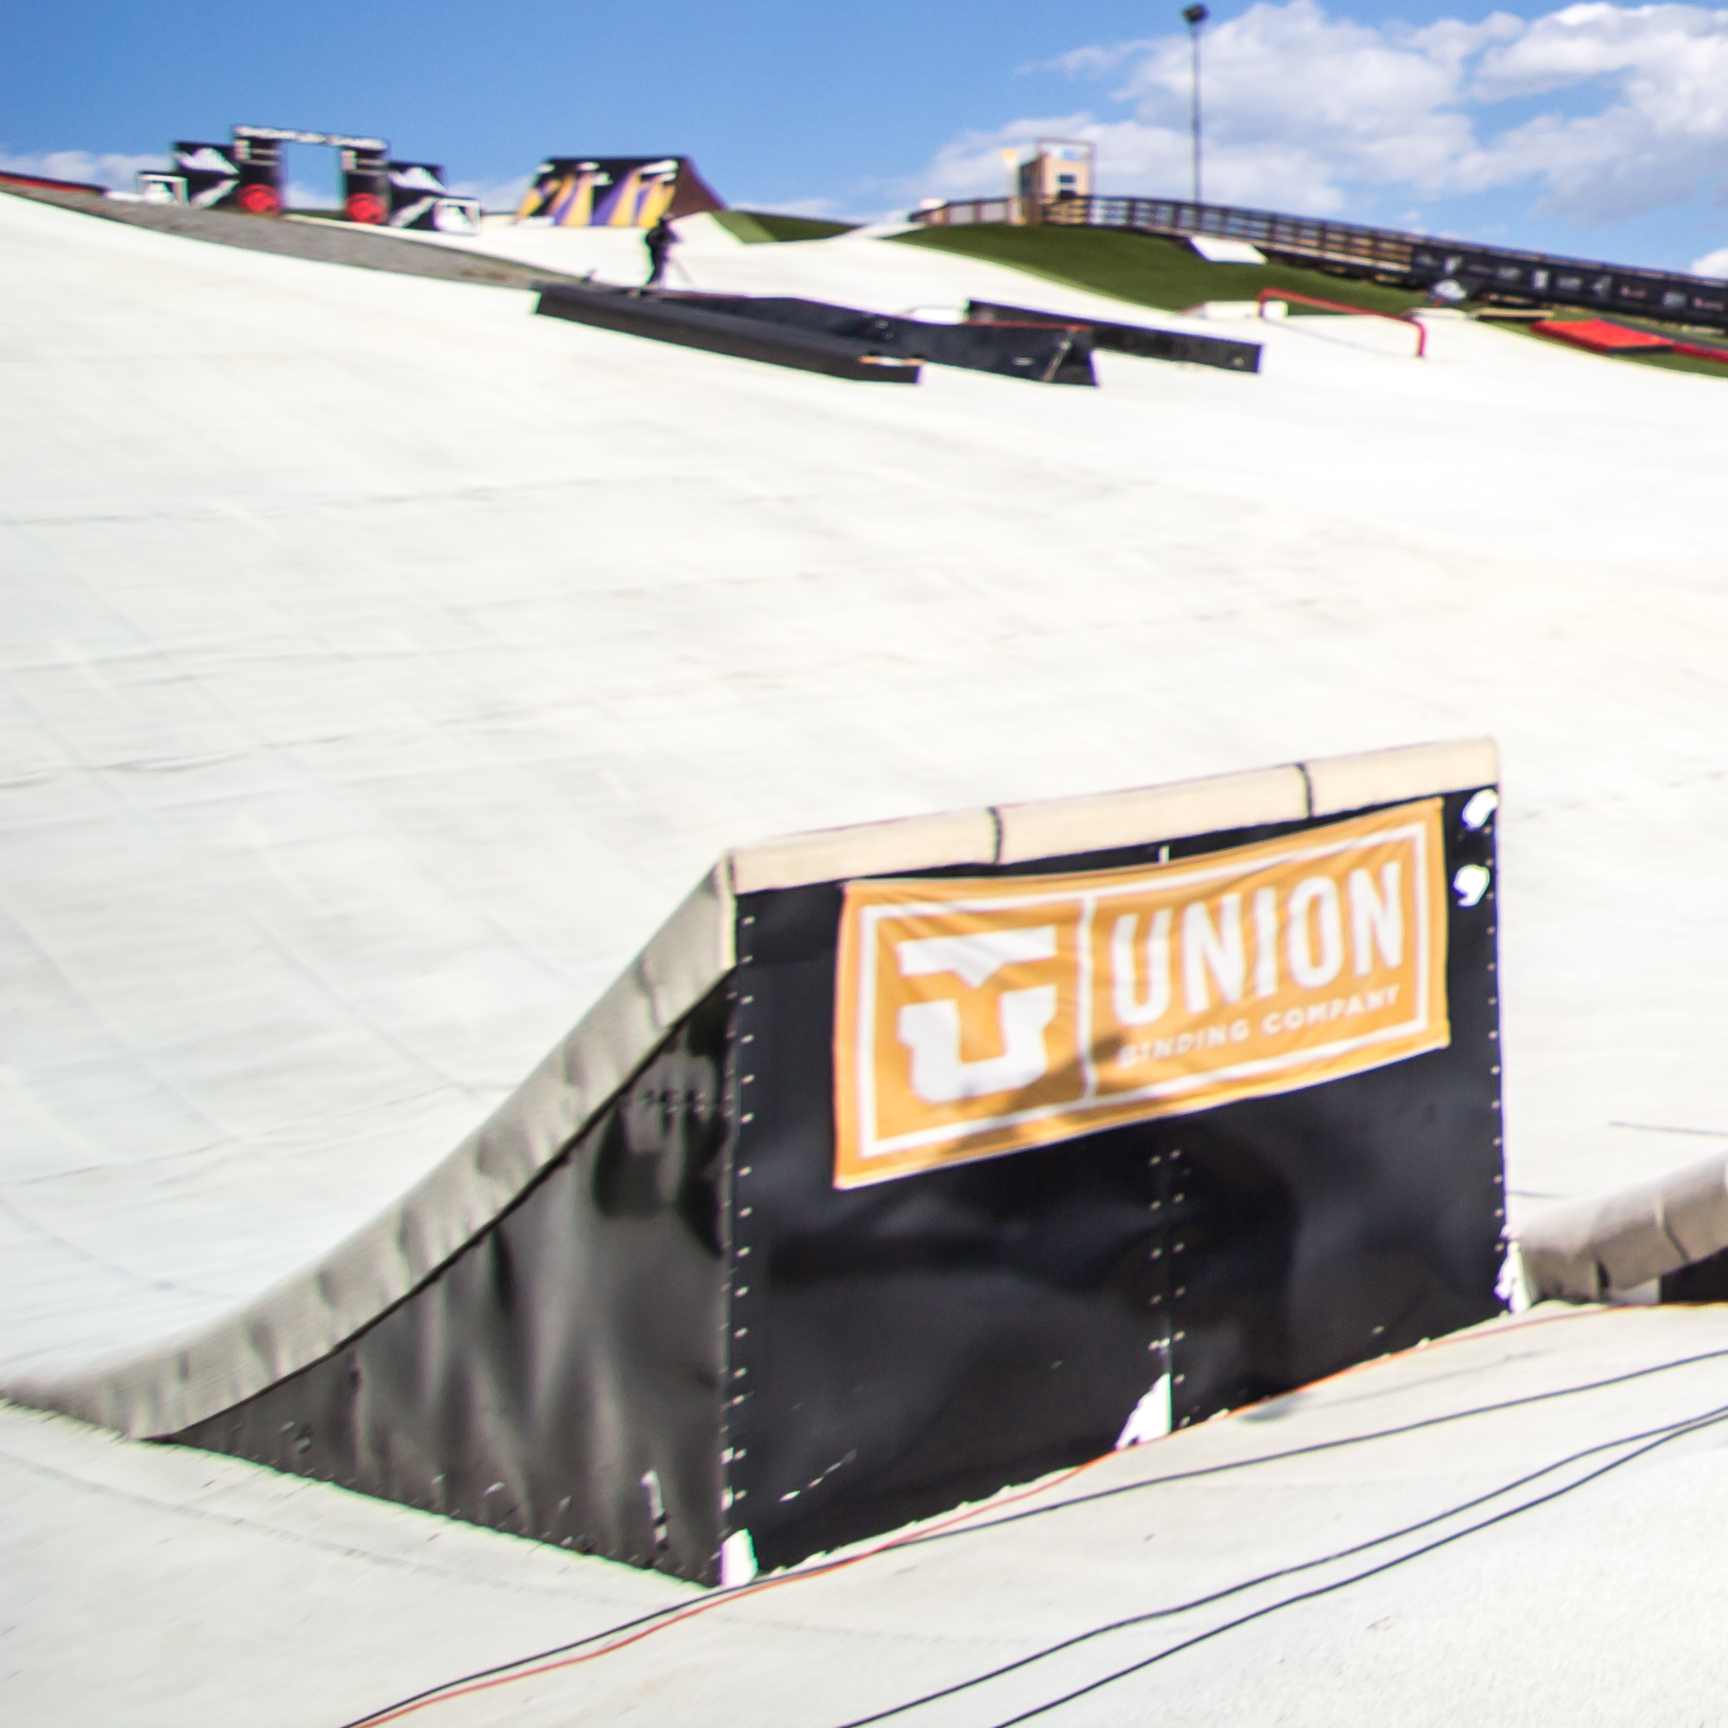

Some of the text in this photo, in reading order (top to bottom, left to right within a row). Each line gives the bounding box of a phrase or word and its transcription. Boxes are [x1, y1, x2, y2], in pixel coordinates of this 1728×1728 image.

[1110, 859, 1403, 1026] UNION
[1117, 984, 1400, 1069] BINDING COMPANY
